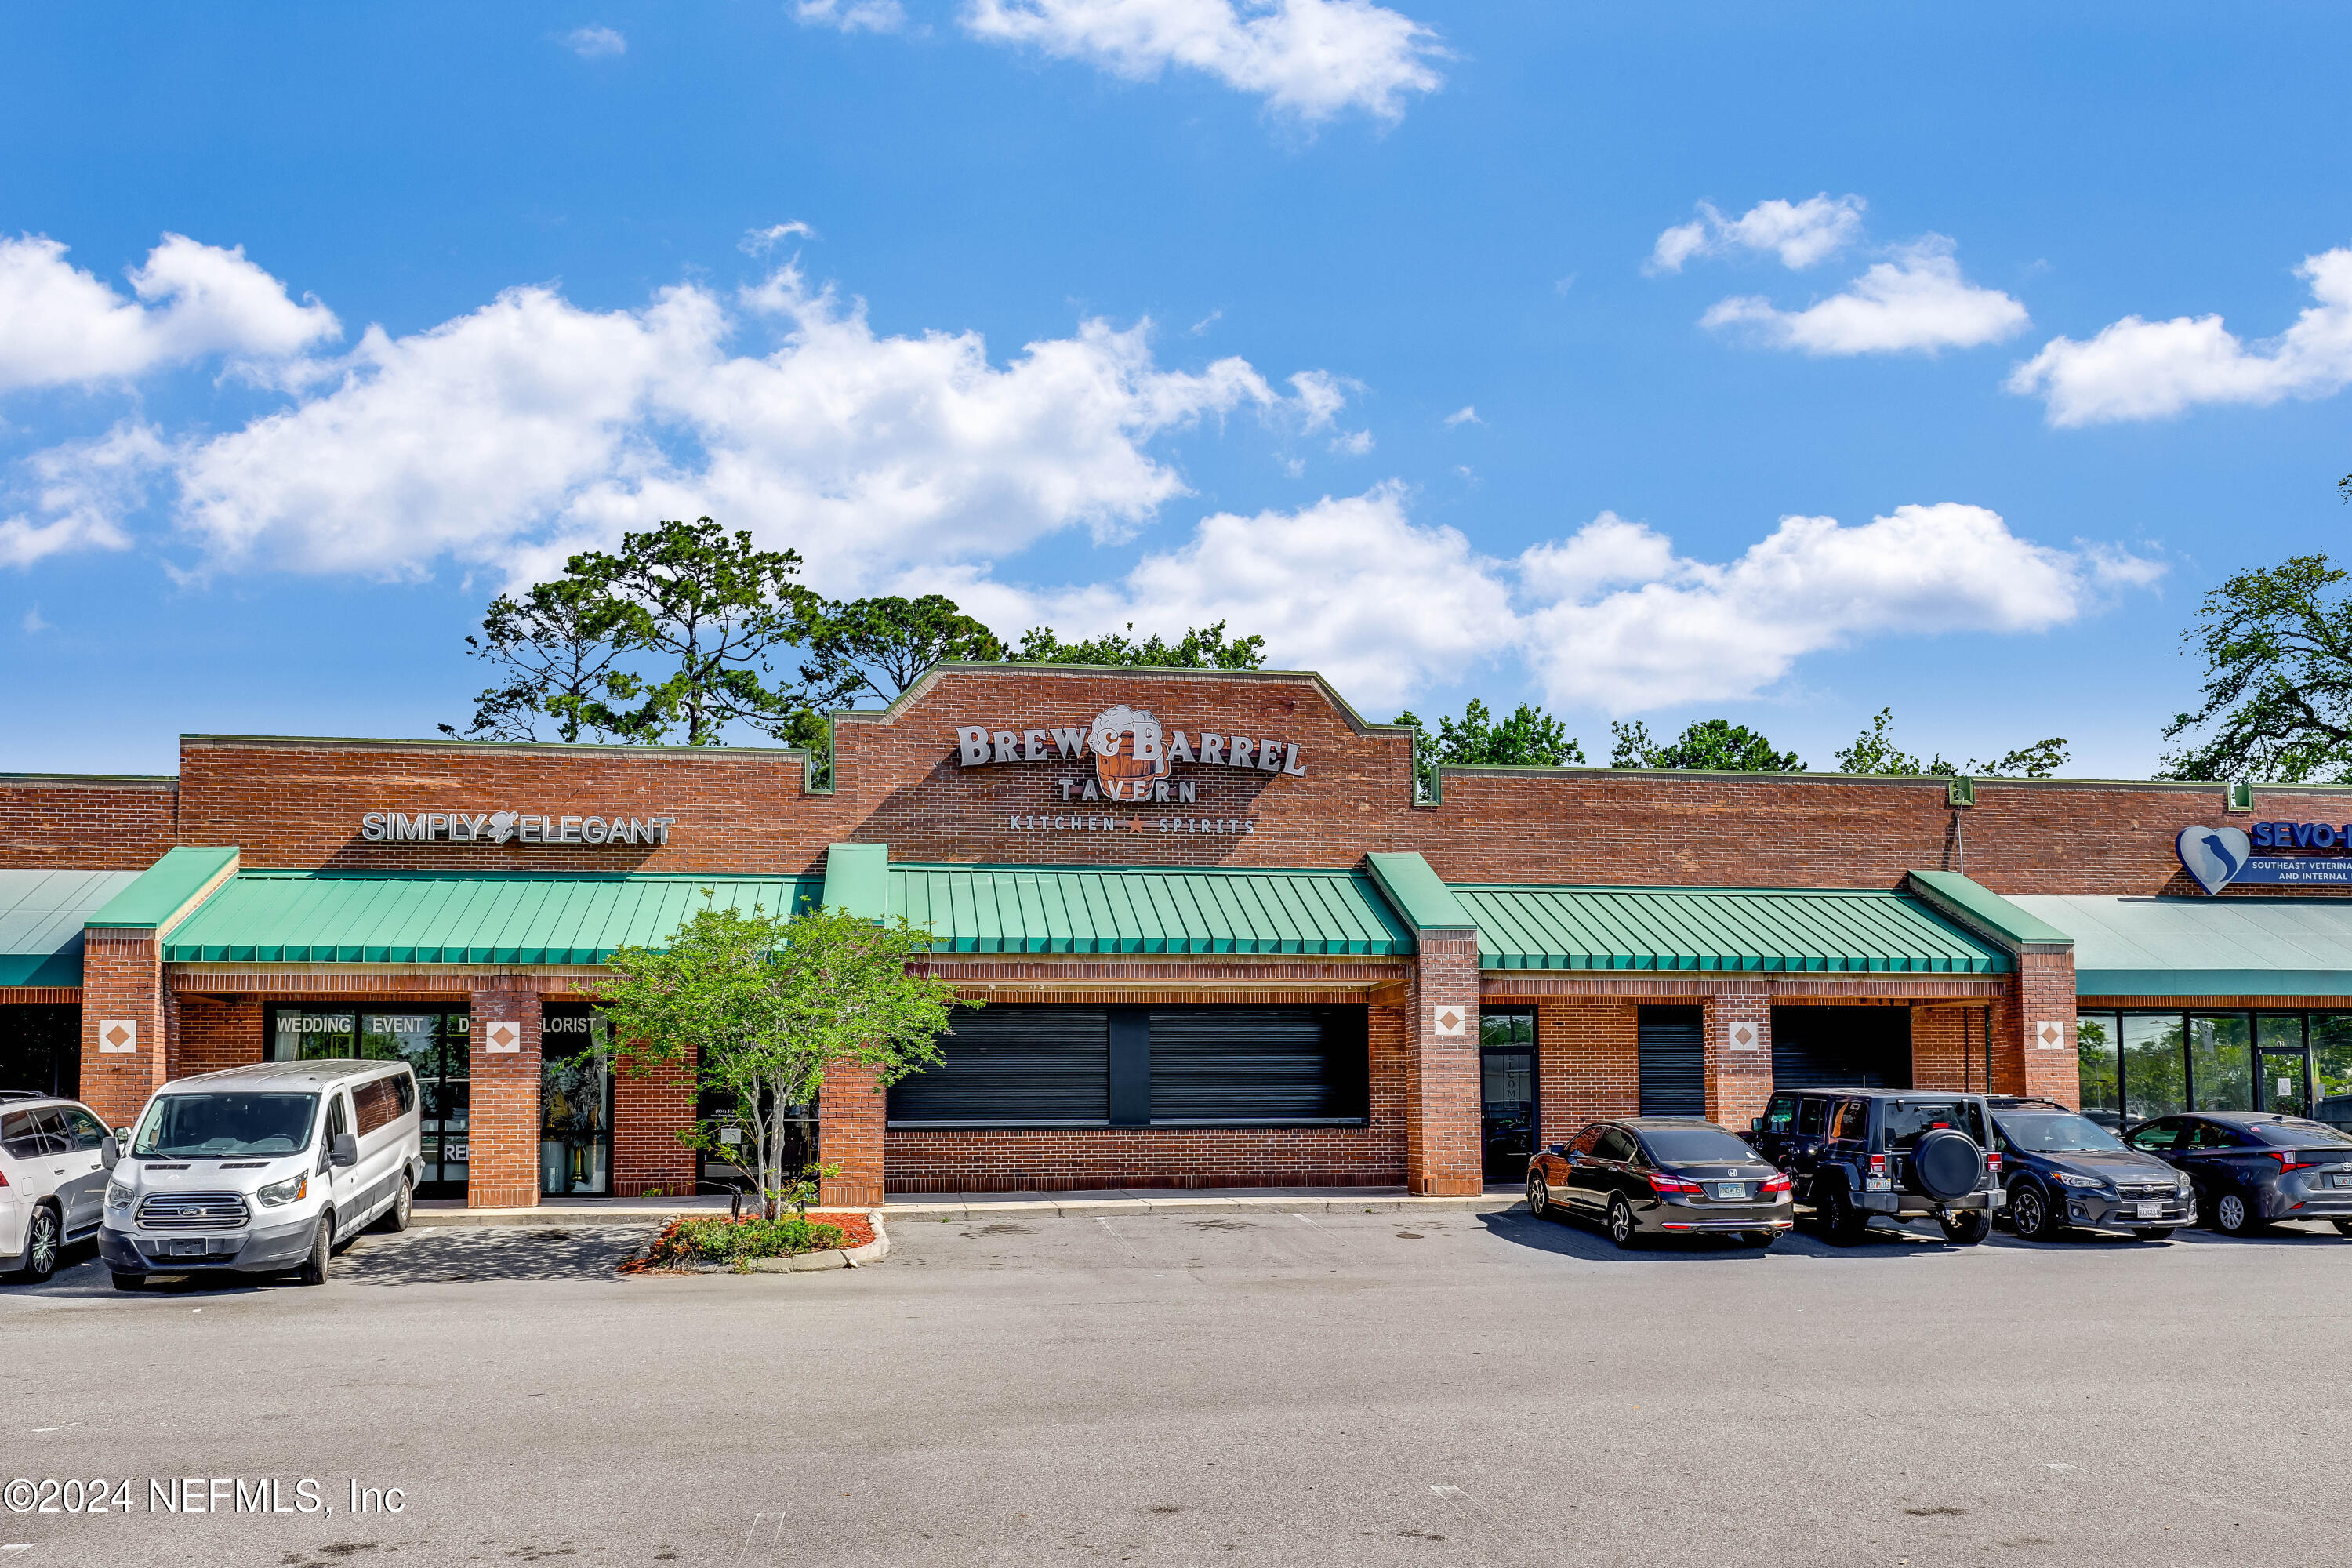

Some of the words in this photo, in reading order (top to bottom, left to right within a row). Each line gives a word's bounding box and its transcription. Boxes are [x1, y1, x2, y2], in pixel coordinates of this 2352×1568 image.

[956, 724, 1091, 768] BREW
[1131, 721, 1307, 778] BARREL
[1058, 779, 1196, 804] TAVERN
[361, 812, 488, 841] SIMPLY
[519, 815, 676, 844] ELEGANT
[1010, 815, 1115, 831] KITCHEN
[1159, 818, 1254, 834] SPIRITS
[2252, 822, 2352, 848] SEVO-
[276, 1017, 351, 1033] WEDDING
[372, 1017, 424, 1033] EVENT
[543, 1018, 597, 1033] LORIST
[1507, 1054, 1515, 1107] ELCOME
